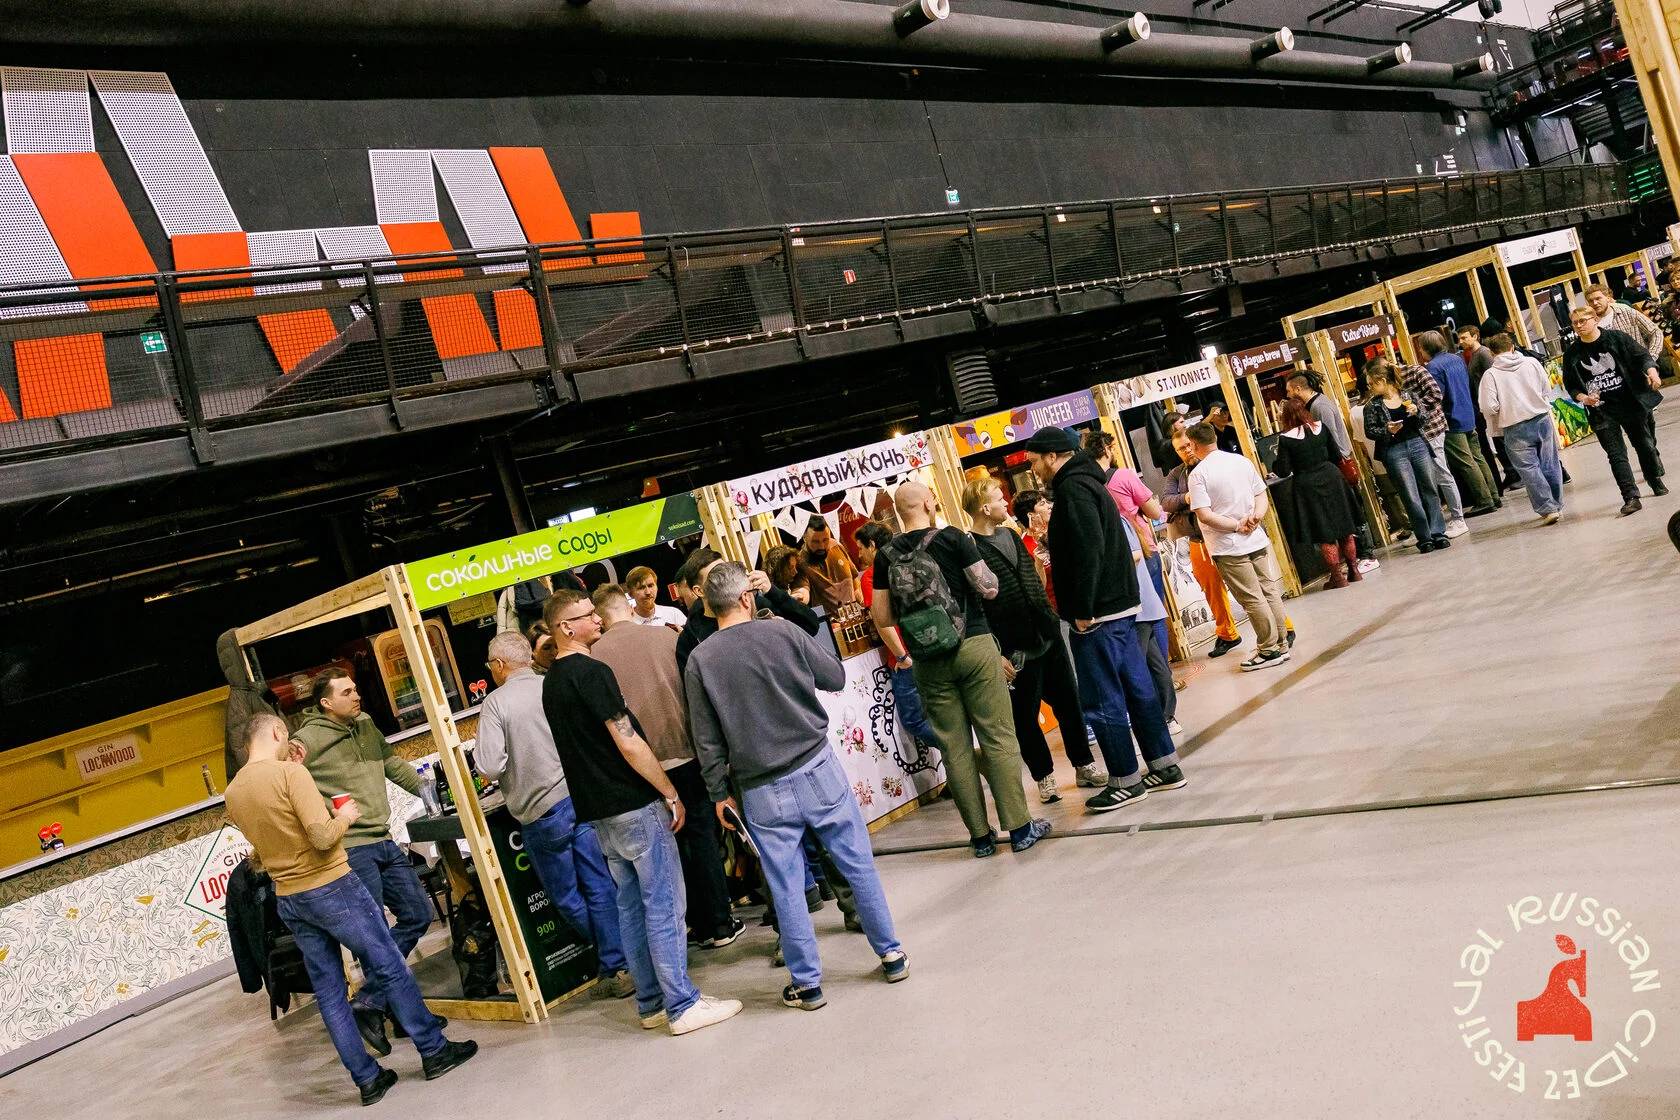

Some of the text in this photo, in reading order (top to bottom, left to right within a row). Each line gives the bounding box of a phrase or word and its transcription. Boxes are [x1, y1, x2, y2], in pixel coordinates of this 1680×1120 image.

[1242, 353, 1265, 371] plague
[1264, 349, 1281, 363] brew
[1156, 366, 1211, 393] ST.VIONNET
[1030, 401, 1074, 431] JUICEFER
[751, 448, 905, 505] КУДРЯВЫЙ КОНЬ
[557, 528, 613, 556] сады
[82, 745, 136, 774] LOCKWOOD
[97, 743, 114, 754] GIN
[223, 848, 249, 867] GIN
[200, 870, 231, 904] LOC
[527, 890, 547, 905] АГРО
[529, 898, 550, 913] ВОРО
[536, 920, 556, 937] 900
